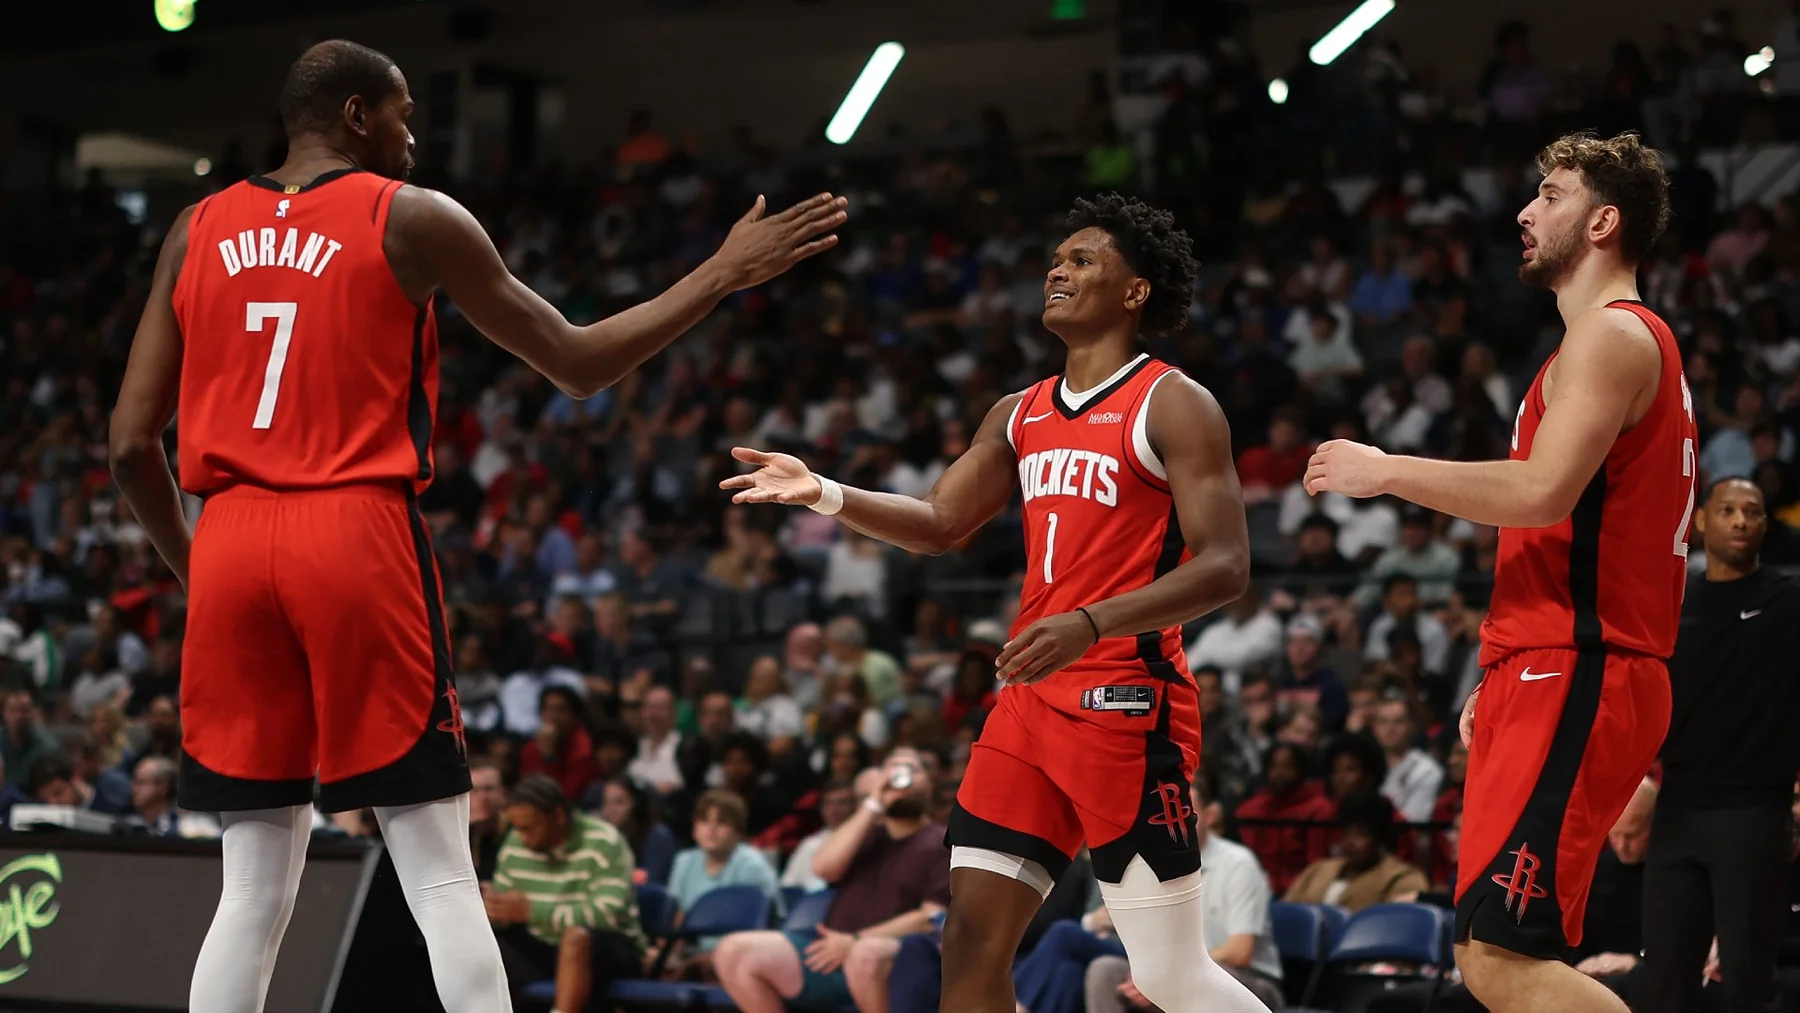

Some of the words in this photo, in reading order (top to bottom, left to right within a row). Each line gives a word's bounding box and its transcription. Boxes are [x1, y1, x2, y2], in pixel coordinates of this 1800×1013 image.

[218, 227, 343, 278] DURANT
[245, 301, 298, 430] 7
[1043, 512, 1058, 584] 1
